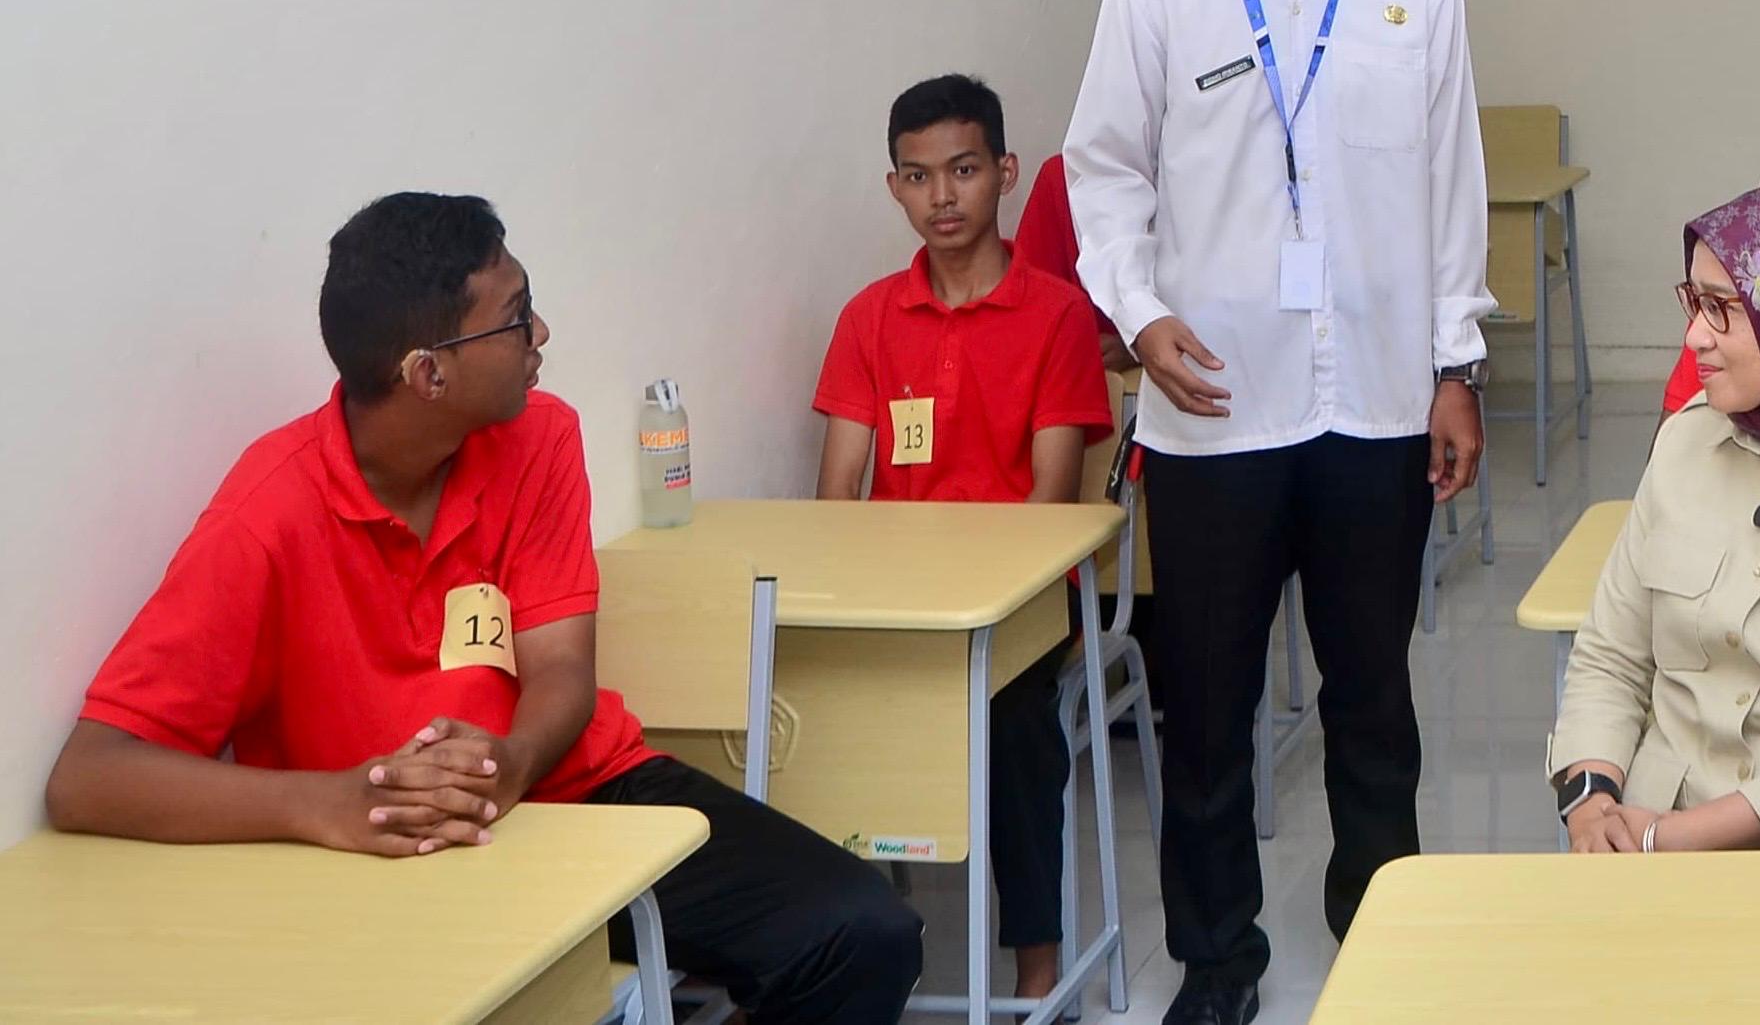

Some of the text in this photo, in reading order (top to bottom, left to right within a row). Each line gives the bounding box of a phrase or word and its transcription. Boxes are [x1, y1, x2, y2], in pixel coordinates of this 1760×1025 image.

[904, 423, 923, 449] 13
[464, 614, 505, 649] 12
[874, 841, 931, 855] Woodland
